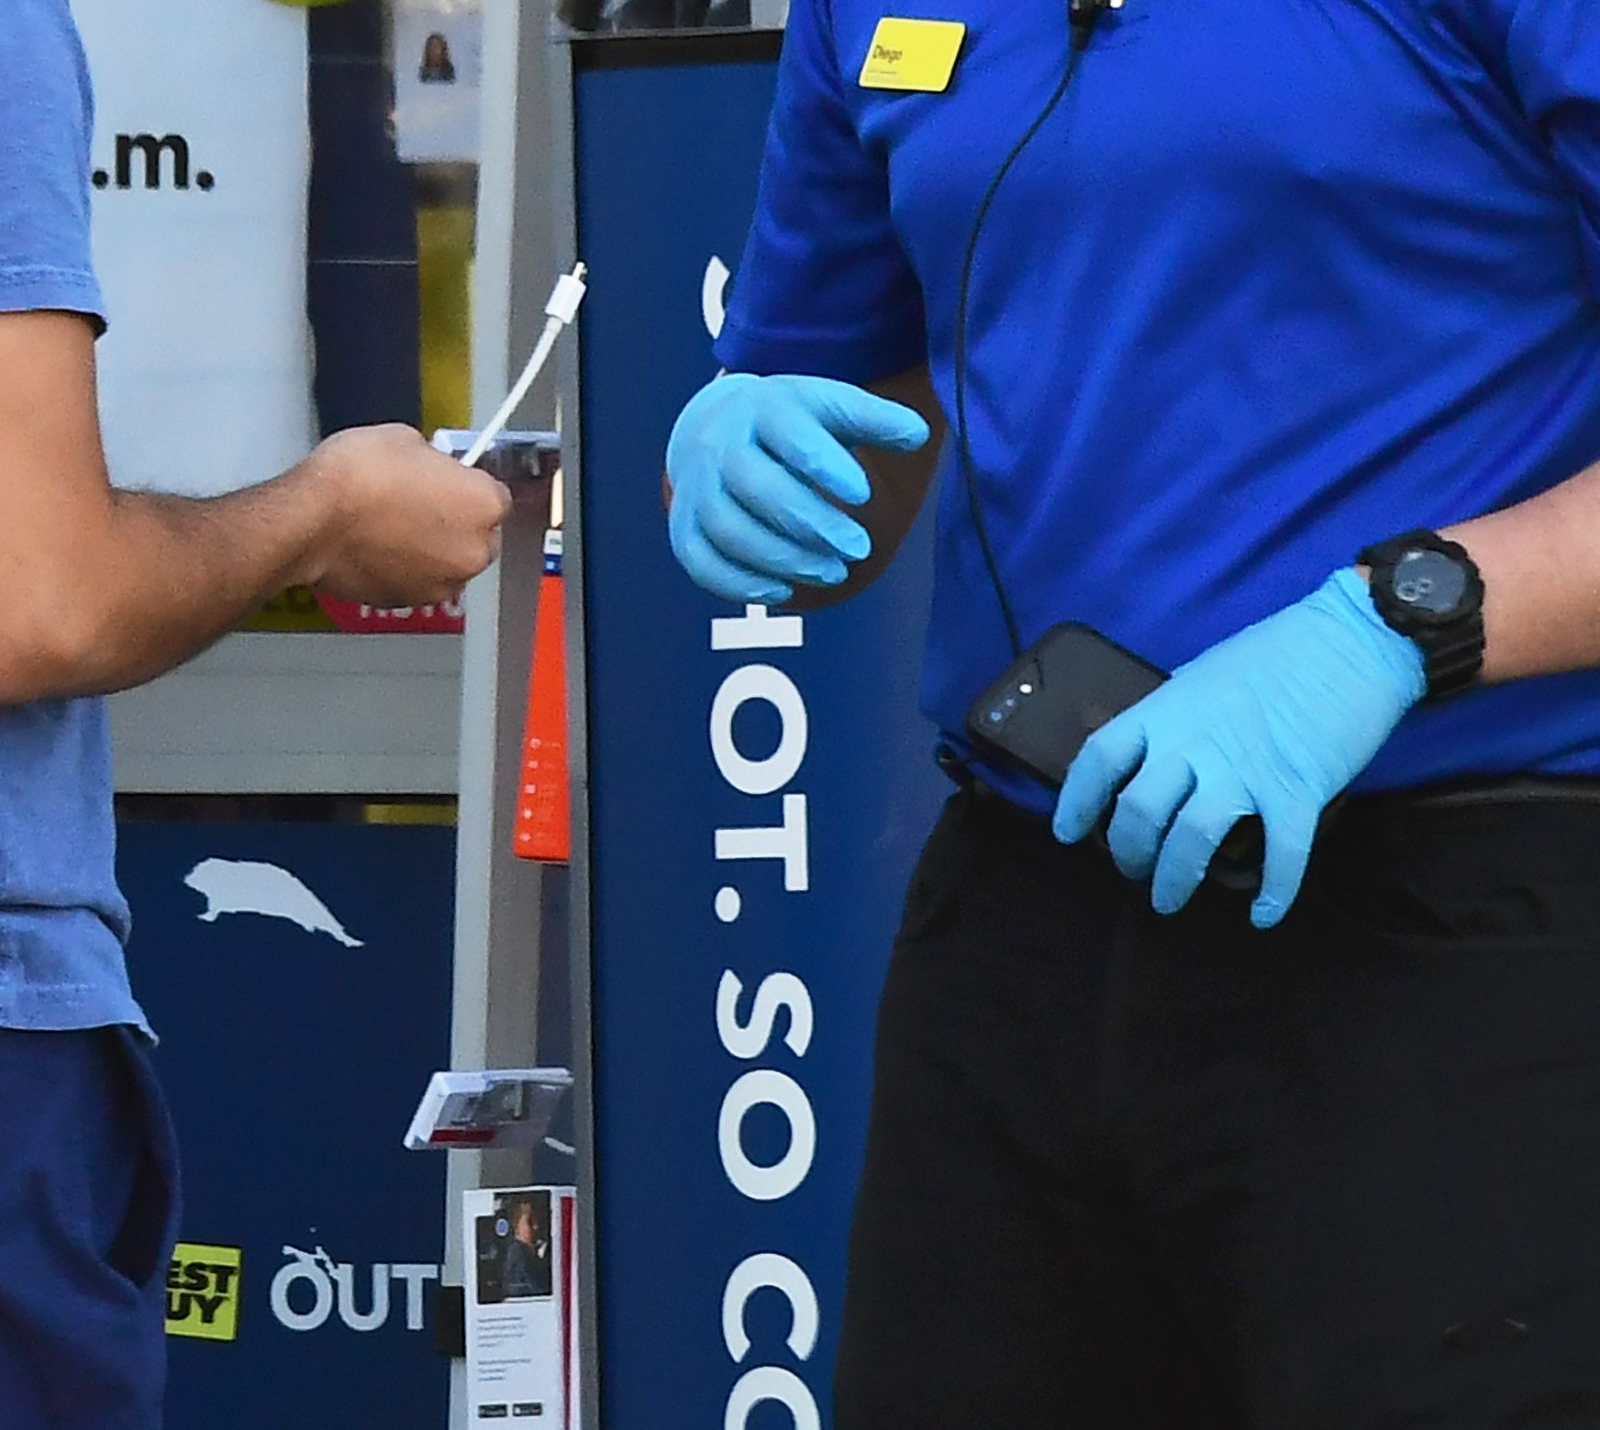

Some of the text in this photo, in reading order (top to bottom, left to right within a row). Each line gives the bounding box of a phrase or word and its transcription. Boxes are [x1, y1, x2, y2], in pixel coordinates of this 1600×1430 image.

[715, 969, 816, 1201] SO
[166, 1260, 238, 1292] EST
[270, 1259, 439, 1332] OUT
[165, 1291, 229, 1324] UY
